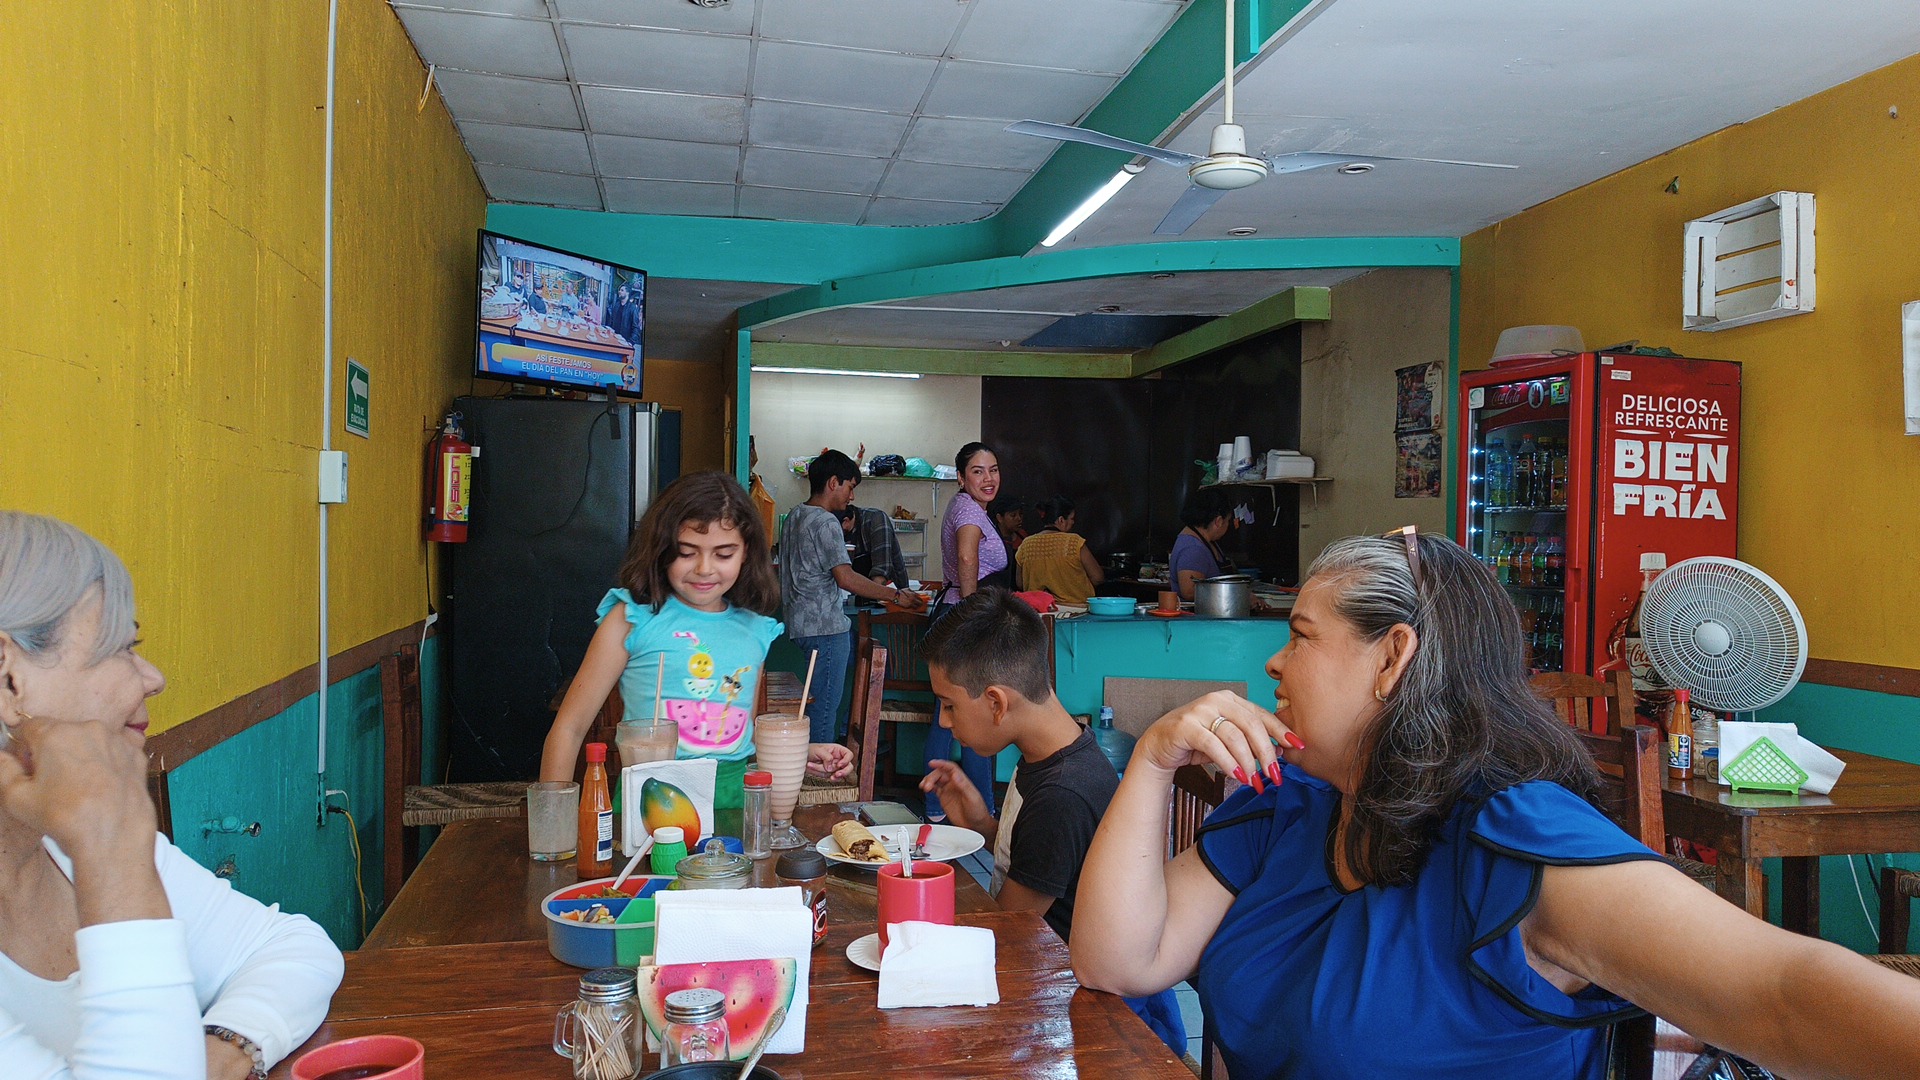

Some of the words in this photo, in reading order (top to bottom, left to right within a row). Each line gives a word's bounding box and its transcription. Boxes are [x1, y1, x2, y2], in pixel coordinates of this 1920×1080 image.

[522, 362, 530, 370] EL
[546, 365, 558, 374] DEL
[560, 367, 573, 376] PAN
[574, 370, 583, 378] EN
[548, 356, 592, 369] FESTEJAMOS
[1622, 394, 1722, 416] DELICIOSA
[1615, 412, 1728, 432] REFRESCANTE
[1614, 438, 1728, 483] BIEN
[1613, 483, 1726, 520] FRÍA
